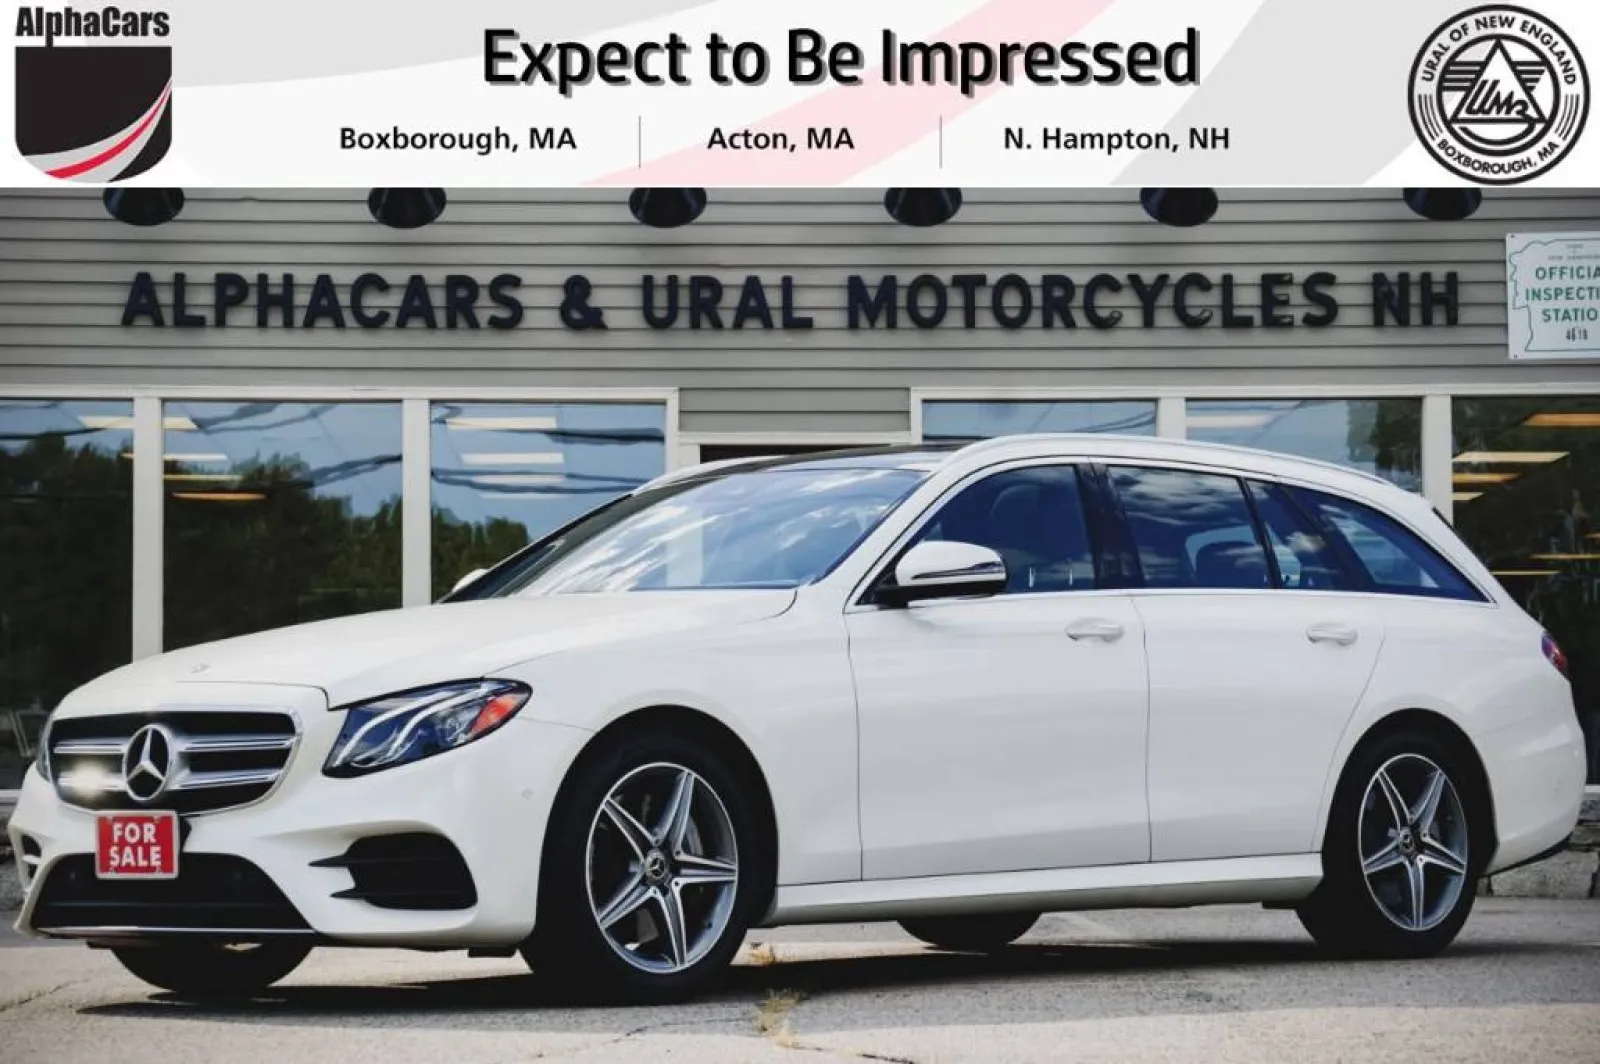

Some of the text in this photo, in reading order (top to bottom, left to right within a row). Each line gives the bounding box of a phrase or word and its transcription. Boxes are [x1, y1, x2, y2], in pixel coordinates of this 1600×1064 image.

[121, 271, 1460, 331] ALPHACARS & URAL MOTORCYCLES NH
[112, 822, 156, 844] FOR
[109, 846, 162, 867] SALE
